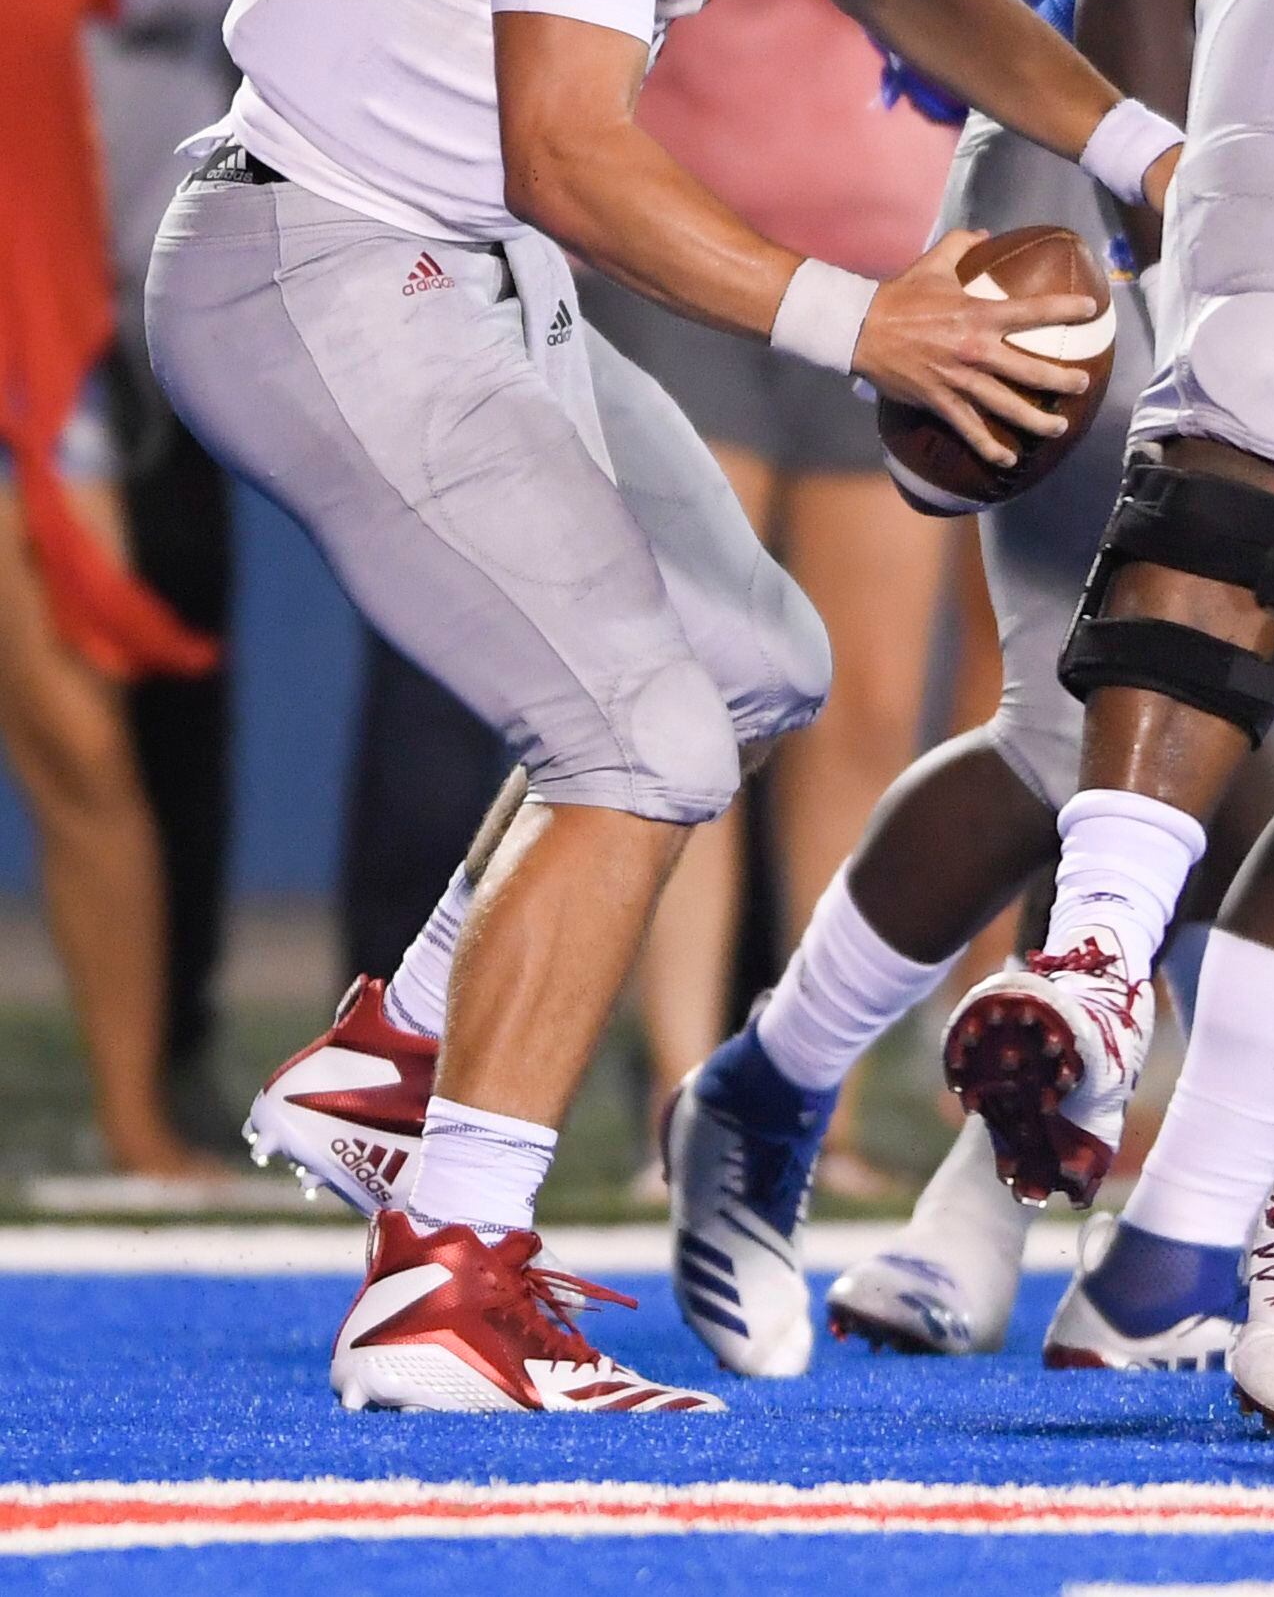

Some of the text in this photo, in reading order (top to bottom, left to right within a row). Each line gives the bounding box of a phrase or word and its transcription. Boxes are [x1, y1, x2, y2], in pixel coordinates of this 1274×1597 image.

[206, 167, 254, 183] adidas
[402, 275, 457, 296] adidas
[331, 1138, 393, 1202] adidas
